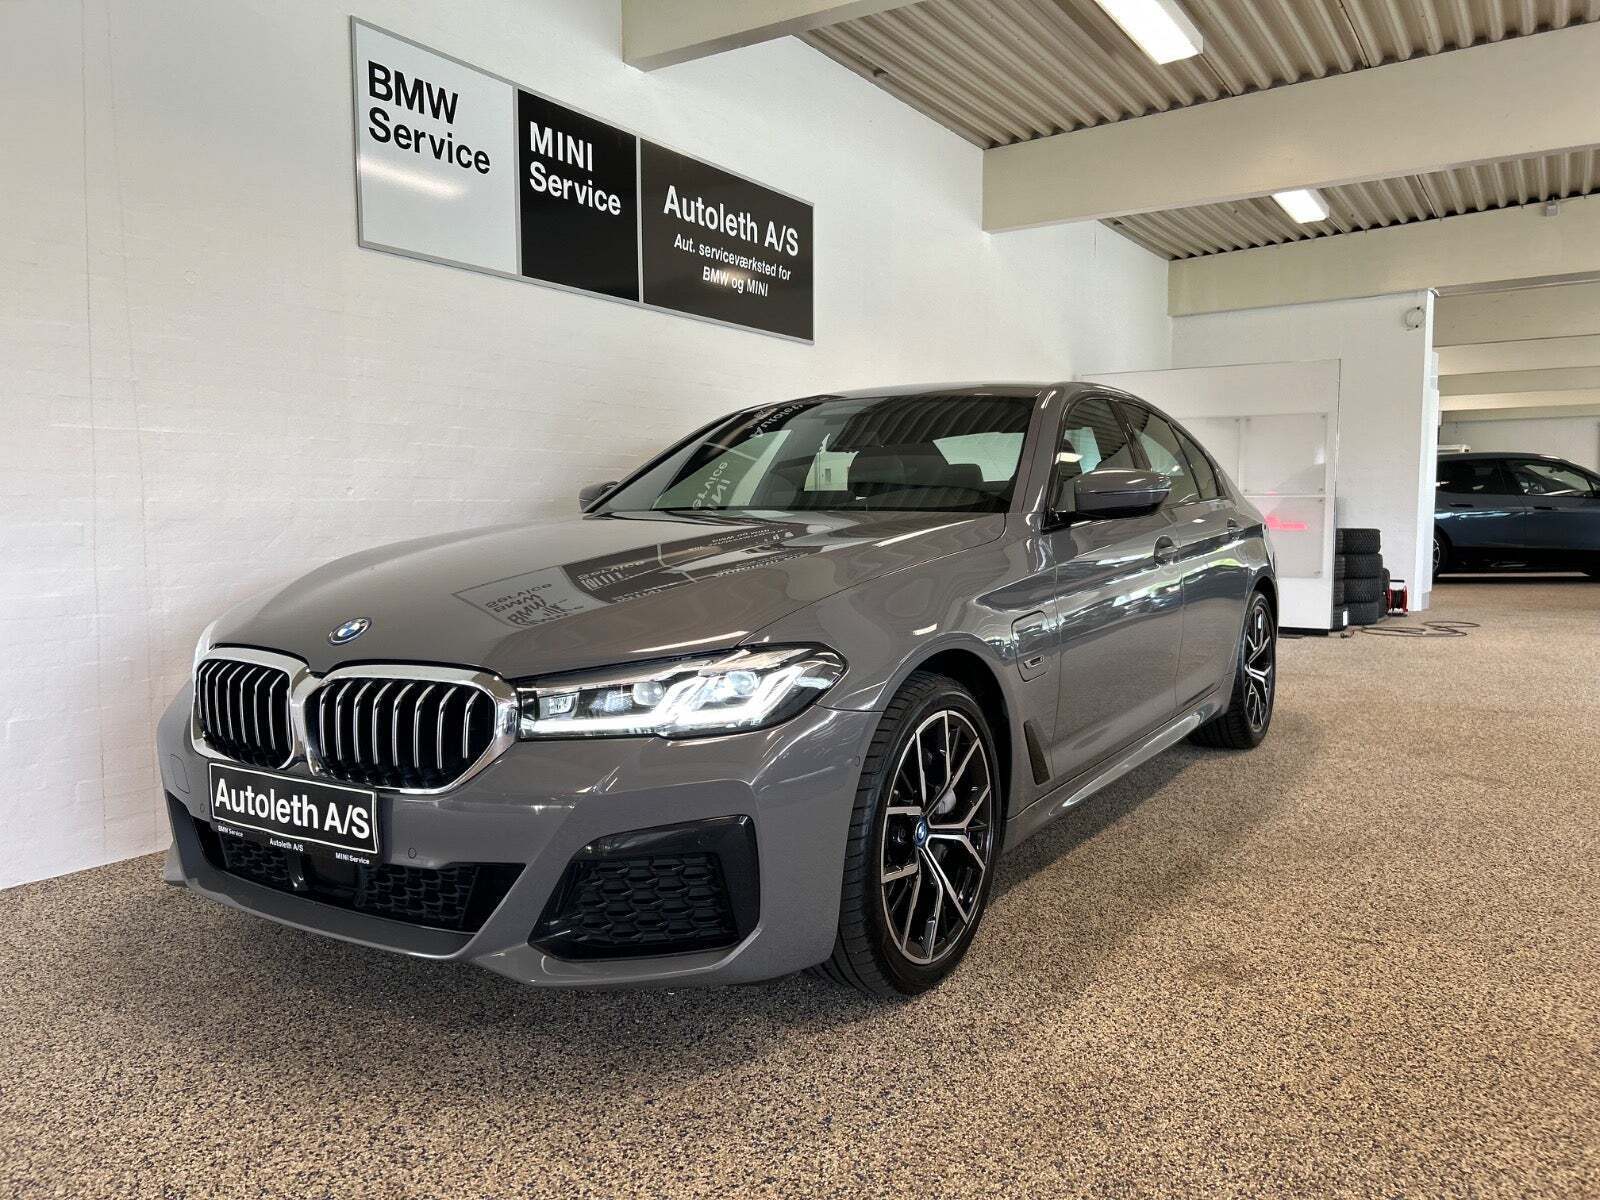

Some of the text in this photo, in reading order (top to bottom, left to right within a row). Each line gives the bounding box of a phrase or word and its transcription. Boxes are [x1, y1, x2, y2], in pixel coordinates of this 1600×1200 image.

[368, 60, 459, 125] BMW
[368, 106, 491, 175] Service
[529, 120, 593, 172] MINI
[529, 161, 621, 216] Service
[663, 184, 799, 257] Autoleth A/S
[673, 233, 792, 281] Aut. serviceværksted for
[702, 265, 769, 297] BMW og MINI
[215, 777, 371, 840] Autoleth A/S
[229, 828, 244, 838] Service
[269, 838, 304, 852] Autoleth A/S
[335, 852, 370, 865] MINI Service
